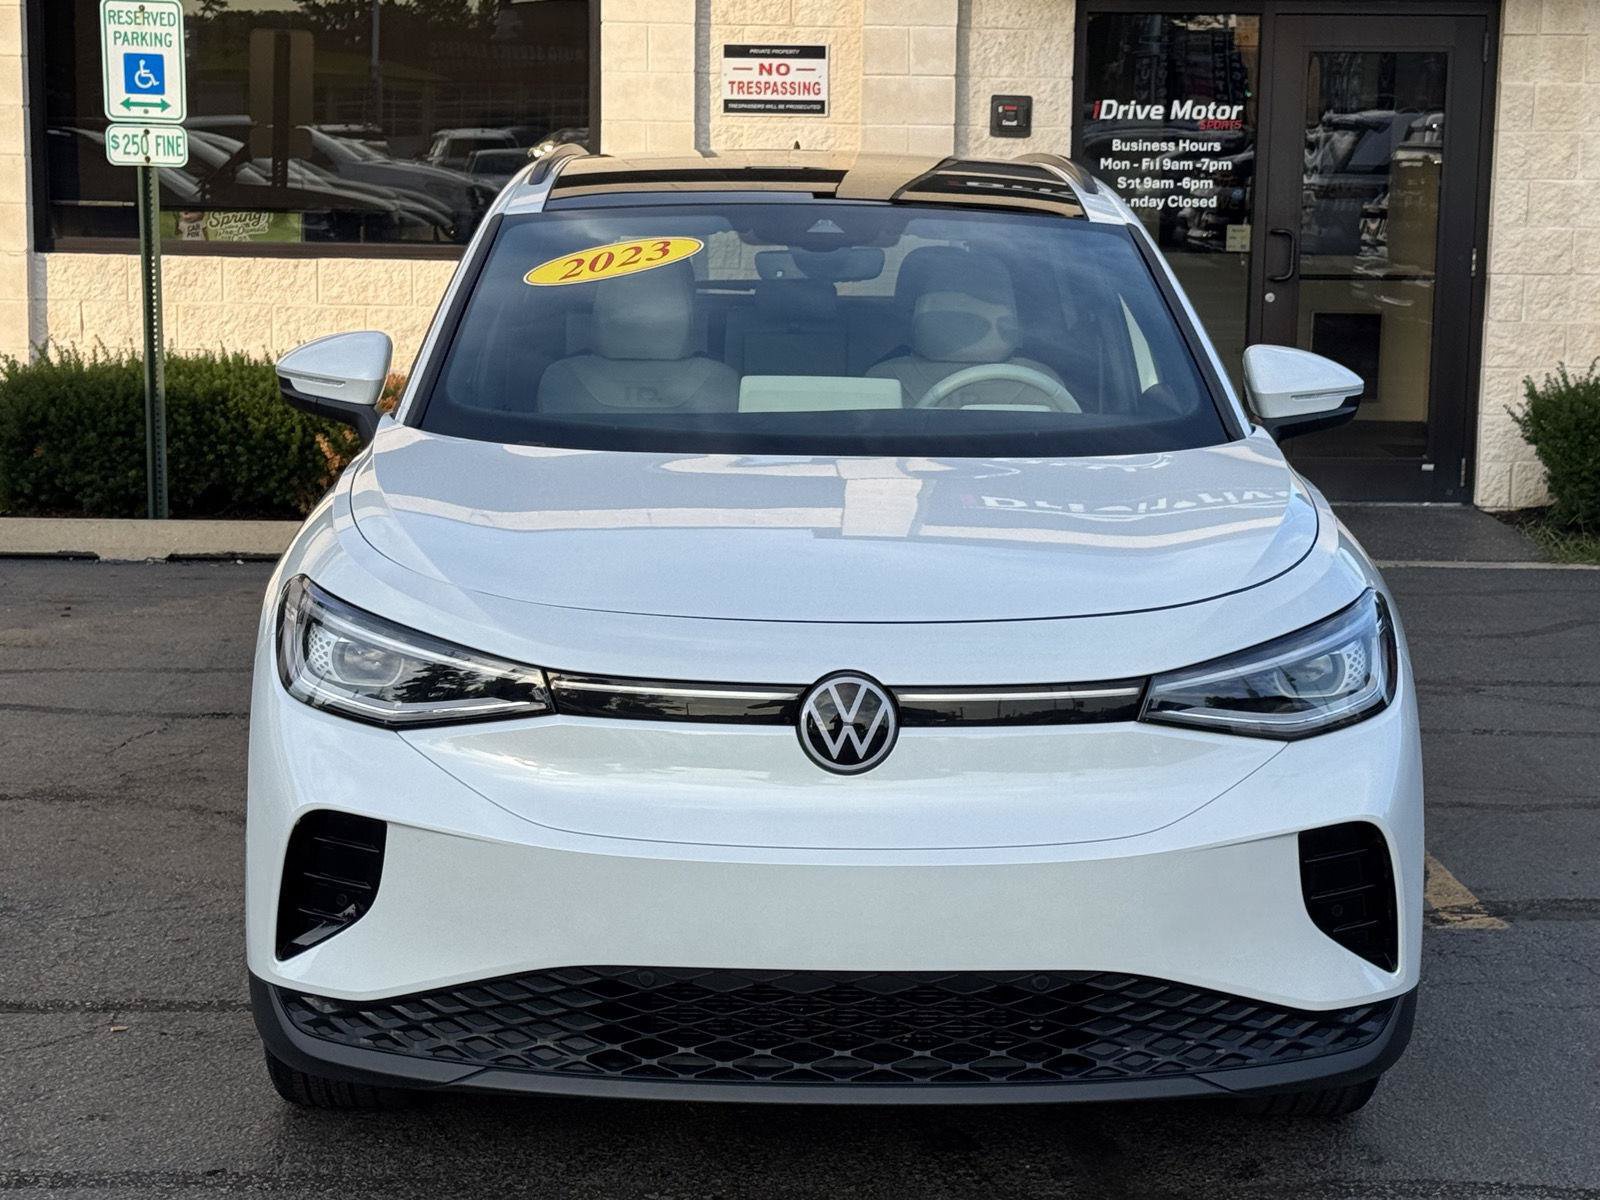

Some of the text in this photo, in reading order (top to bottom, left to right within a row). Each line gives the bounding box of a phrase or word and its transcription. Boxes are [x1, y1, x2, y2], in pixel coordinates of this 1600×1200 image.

[108, 10, 176, 27] RESERVED
[113, 31, 173, 48] PARKING
[758, 63, 791, 76] NO
[728, 81, 822, 96] TRESPASSING
[1092, 99, 1244, 120] iDrive Motor
[1199, 120, 1243, 130] SPORTS
[155, 135, 184, 157] FINE
[1112, 139, 1221, 151] Business Hours
[1100, 158, 1130, 170] Mon
[1162, 158, 1193, 170] 9am
[1143, 177, 1174, 189] 9am
[1122, 196, 1217, 210] nday Closed
[559, 241, 671, 281] 2023
